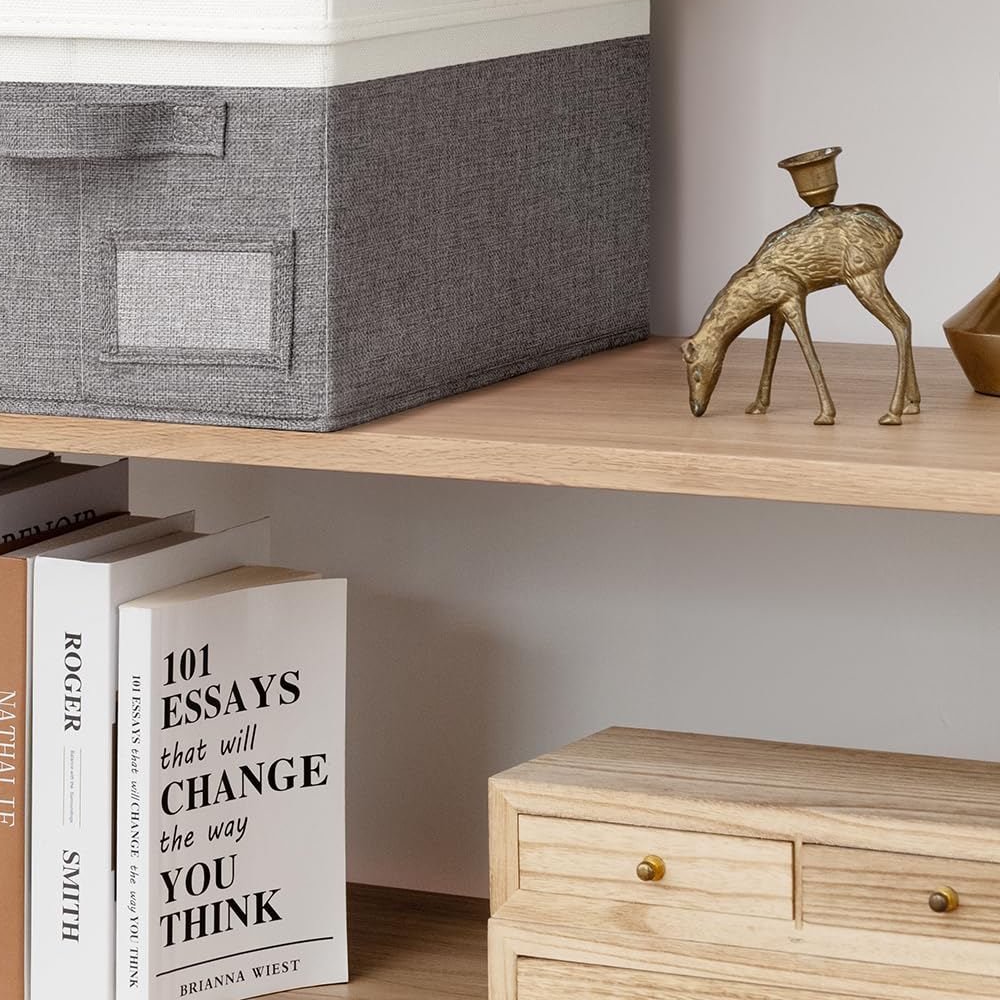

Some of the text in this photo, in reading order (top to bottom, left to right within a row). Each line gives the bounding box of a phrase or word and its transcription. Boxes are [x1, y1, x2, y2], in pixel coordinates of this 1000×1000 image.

[63, 631, 83, 732] ROGER
[163, 643, 212, 687] 101
[161, 670, 301, 730] ESSAYS
[161, 723, 257, 770] that will
[161, 753, 329, 816] CHANGE
[127, 675, 141, 989] 101 ESSAYS that will CHANGE the way YOU THINK
[160, 816, 248, 853] the way
[61, 849, 81, 943] SMITH
[160, 853, 238, 904] YOU
[159, 888, 283, 948] THINK
[179, 959, 301, 997] BRIANNA WIEST
